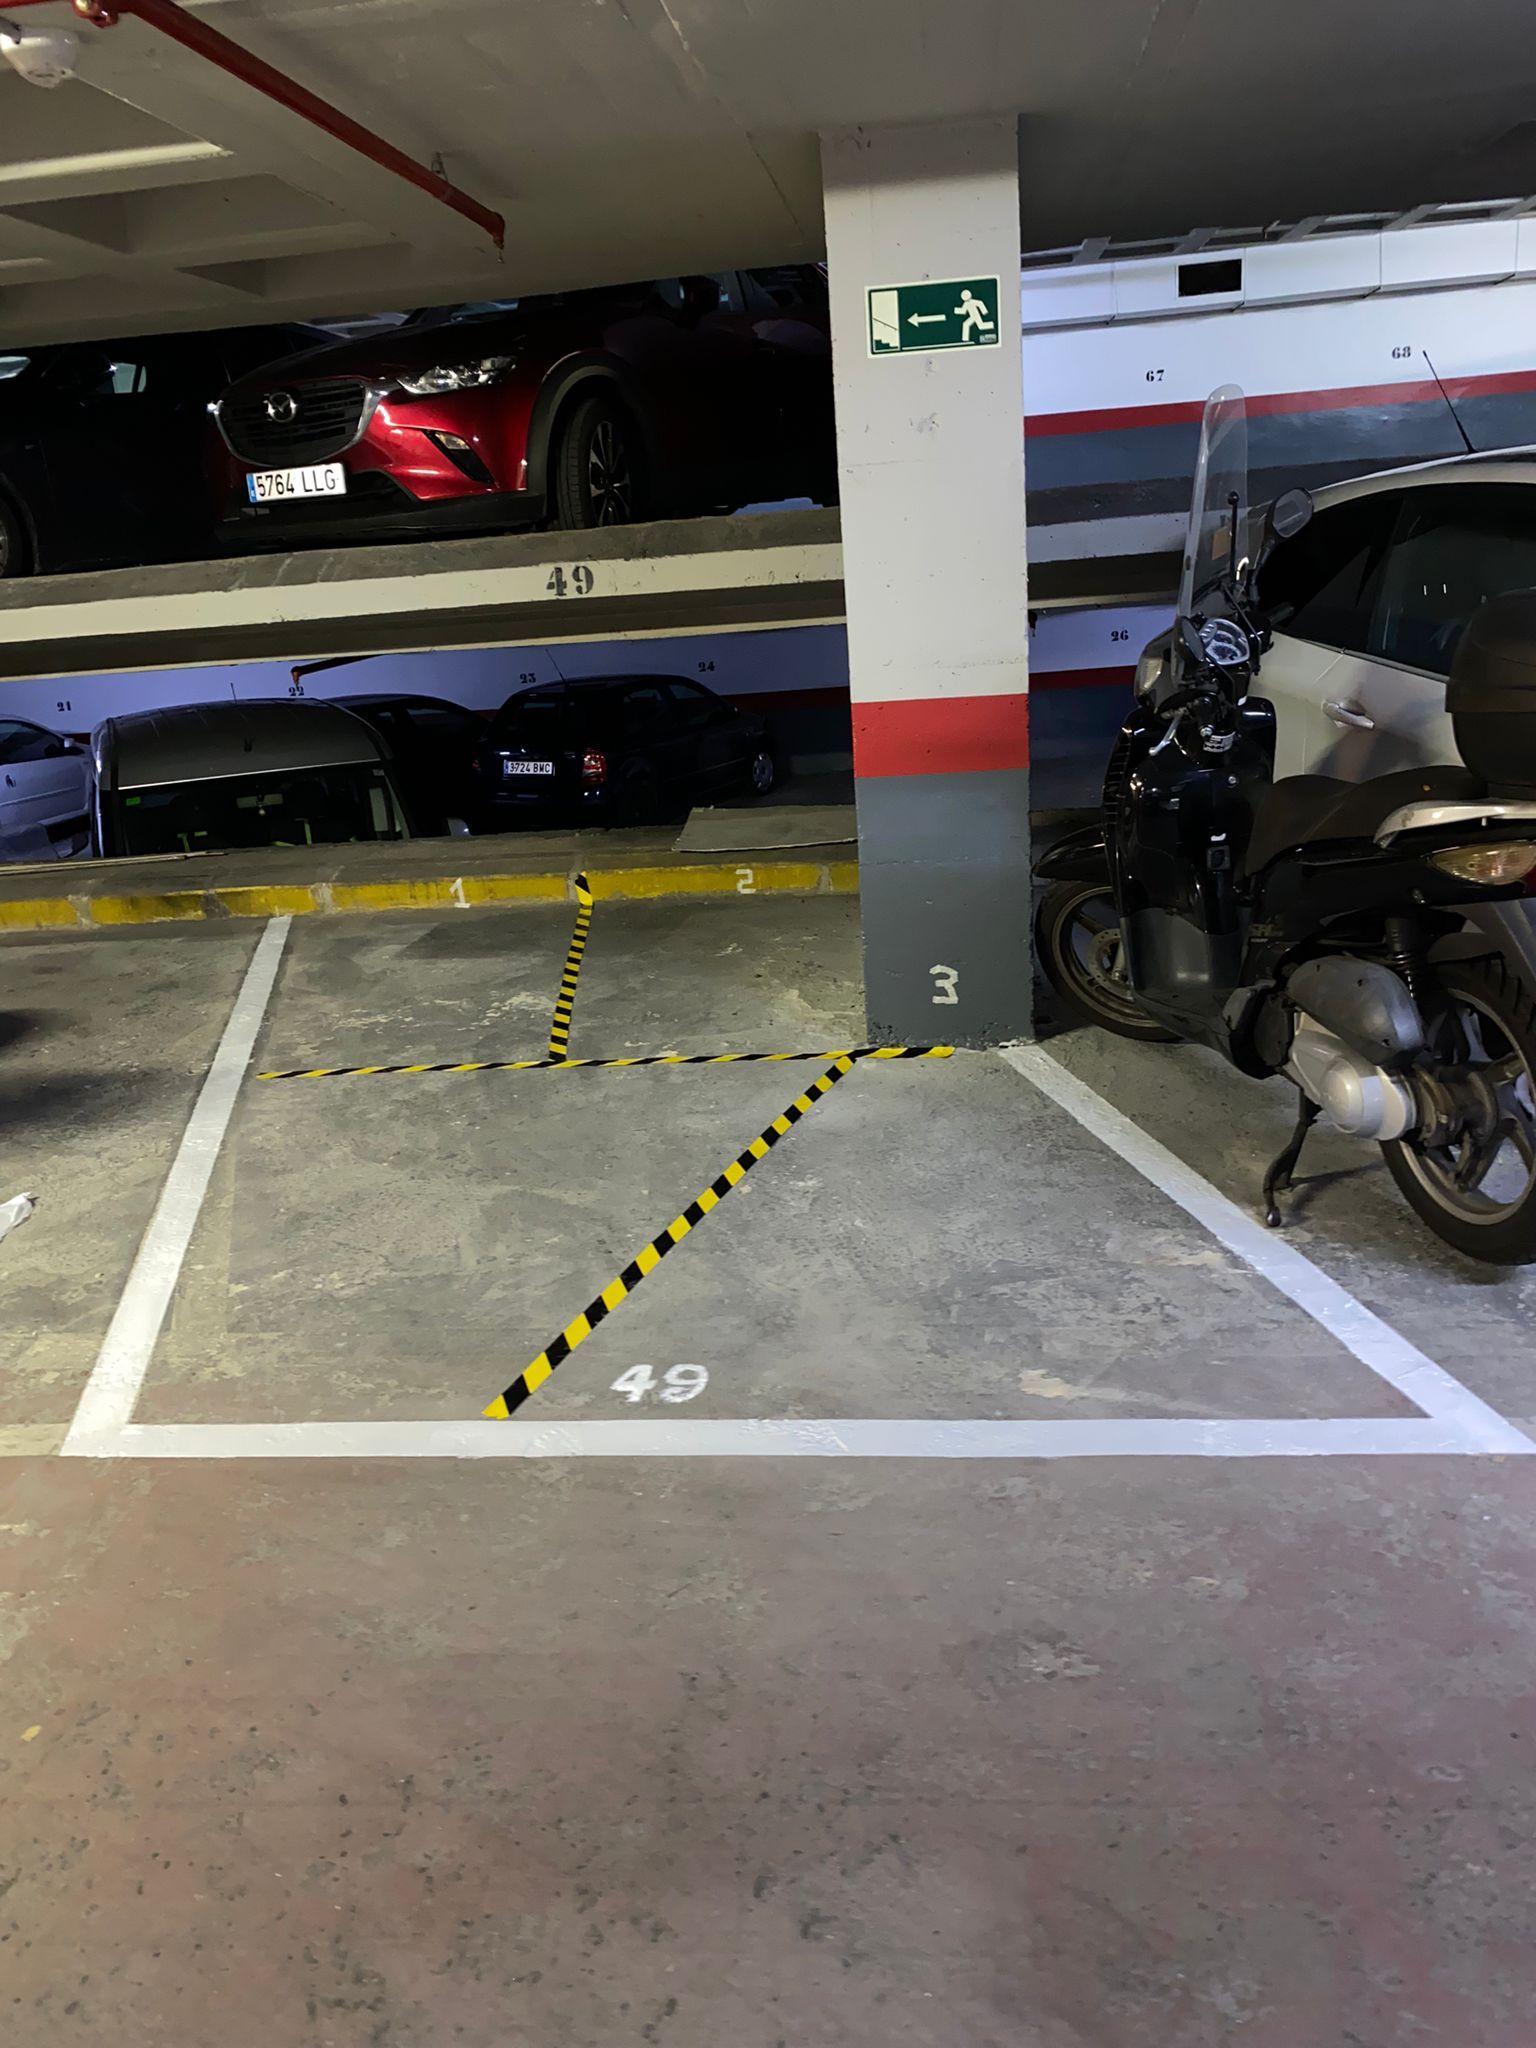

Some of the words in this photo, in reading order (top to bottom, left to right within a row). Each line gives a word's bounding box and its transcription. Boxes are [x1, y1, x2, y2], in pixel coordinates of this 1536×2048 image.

[1391, 346, 1412, 359] 68
[1145, 369, 1165, 382] 67
[256, 472, 295, 497] 5764
[301, 469, 336, 493] LLG
[546, 565, 594, 597] 49
[1110, 629, 1129, 642] 26
[698, 660, 716, 673] 24
[519, 672, 537, 684] 23
[288, 685, 305, 697] 22
[56, 700, 72, 712] 21
[735, 868, 757, 895] 2
[448, 877, 471, 909] 1
[929, 964, 959, 1005] 3
[609, 1363, 709, 1403] 49
